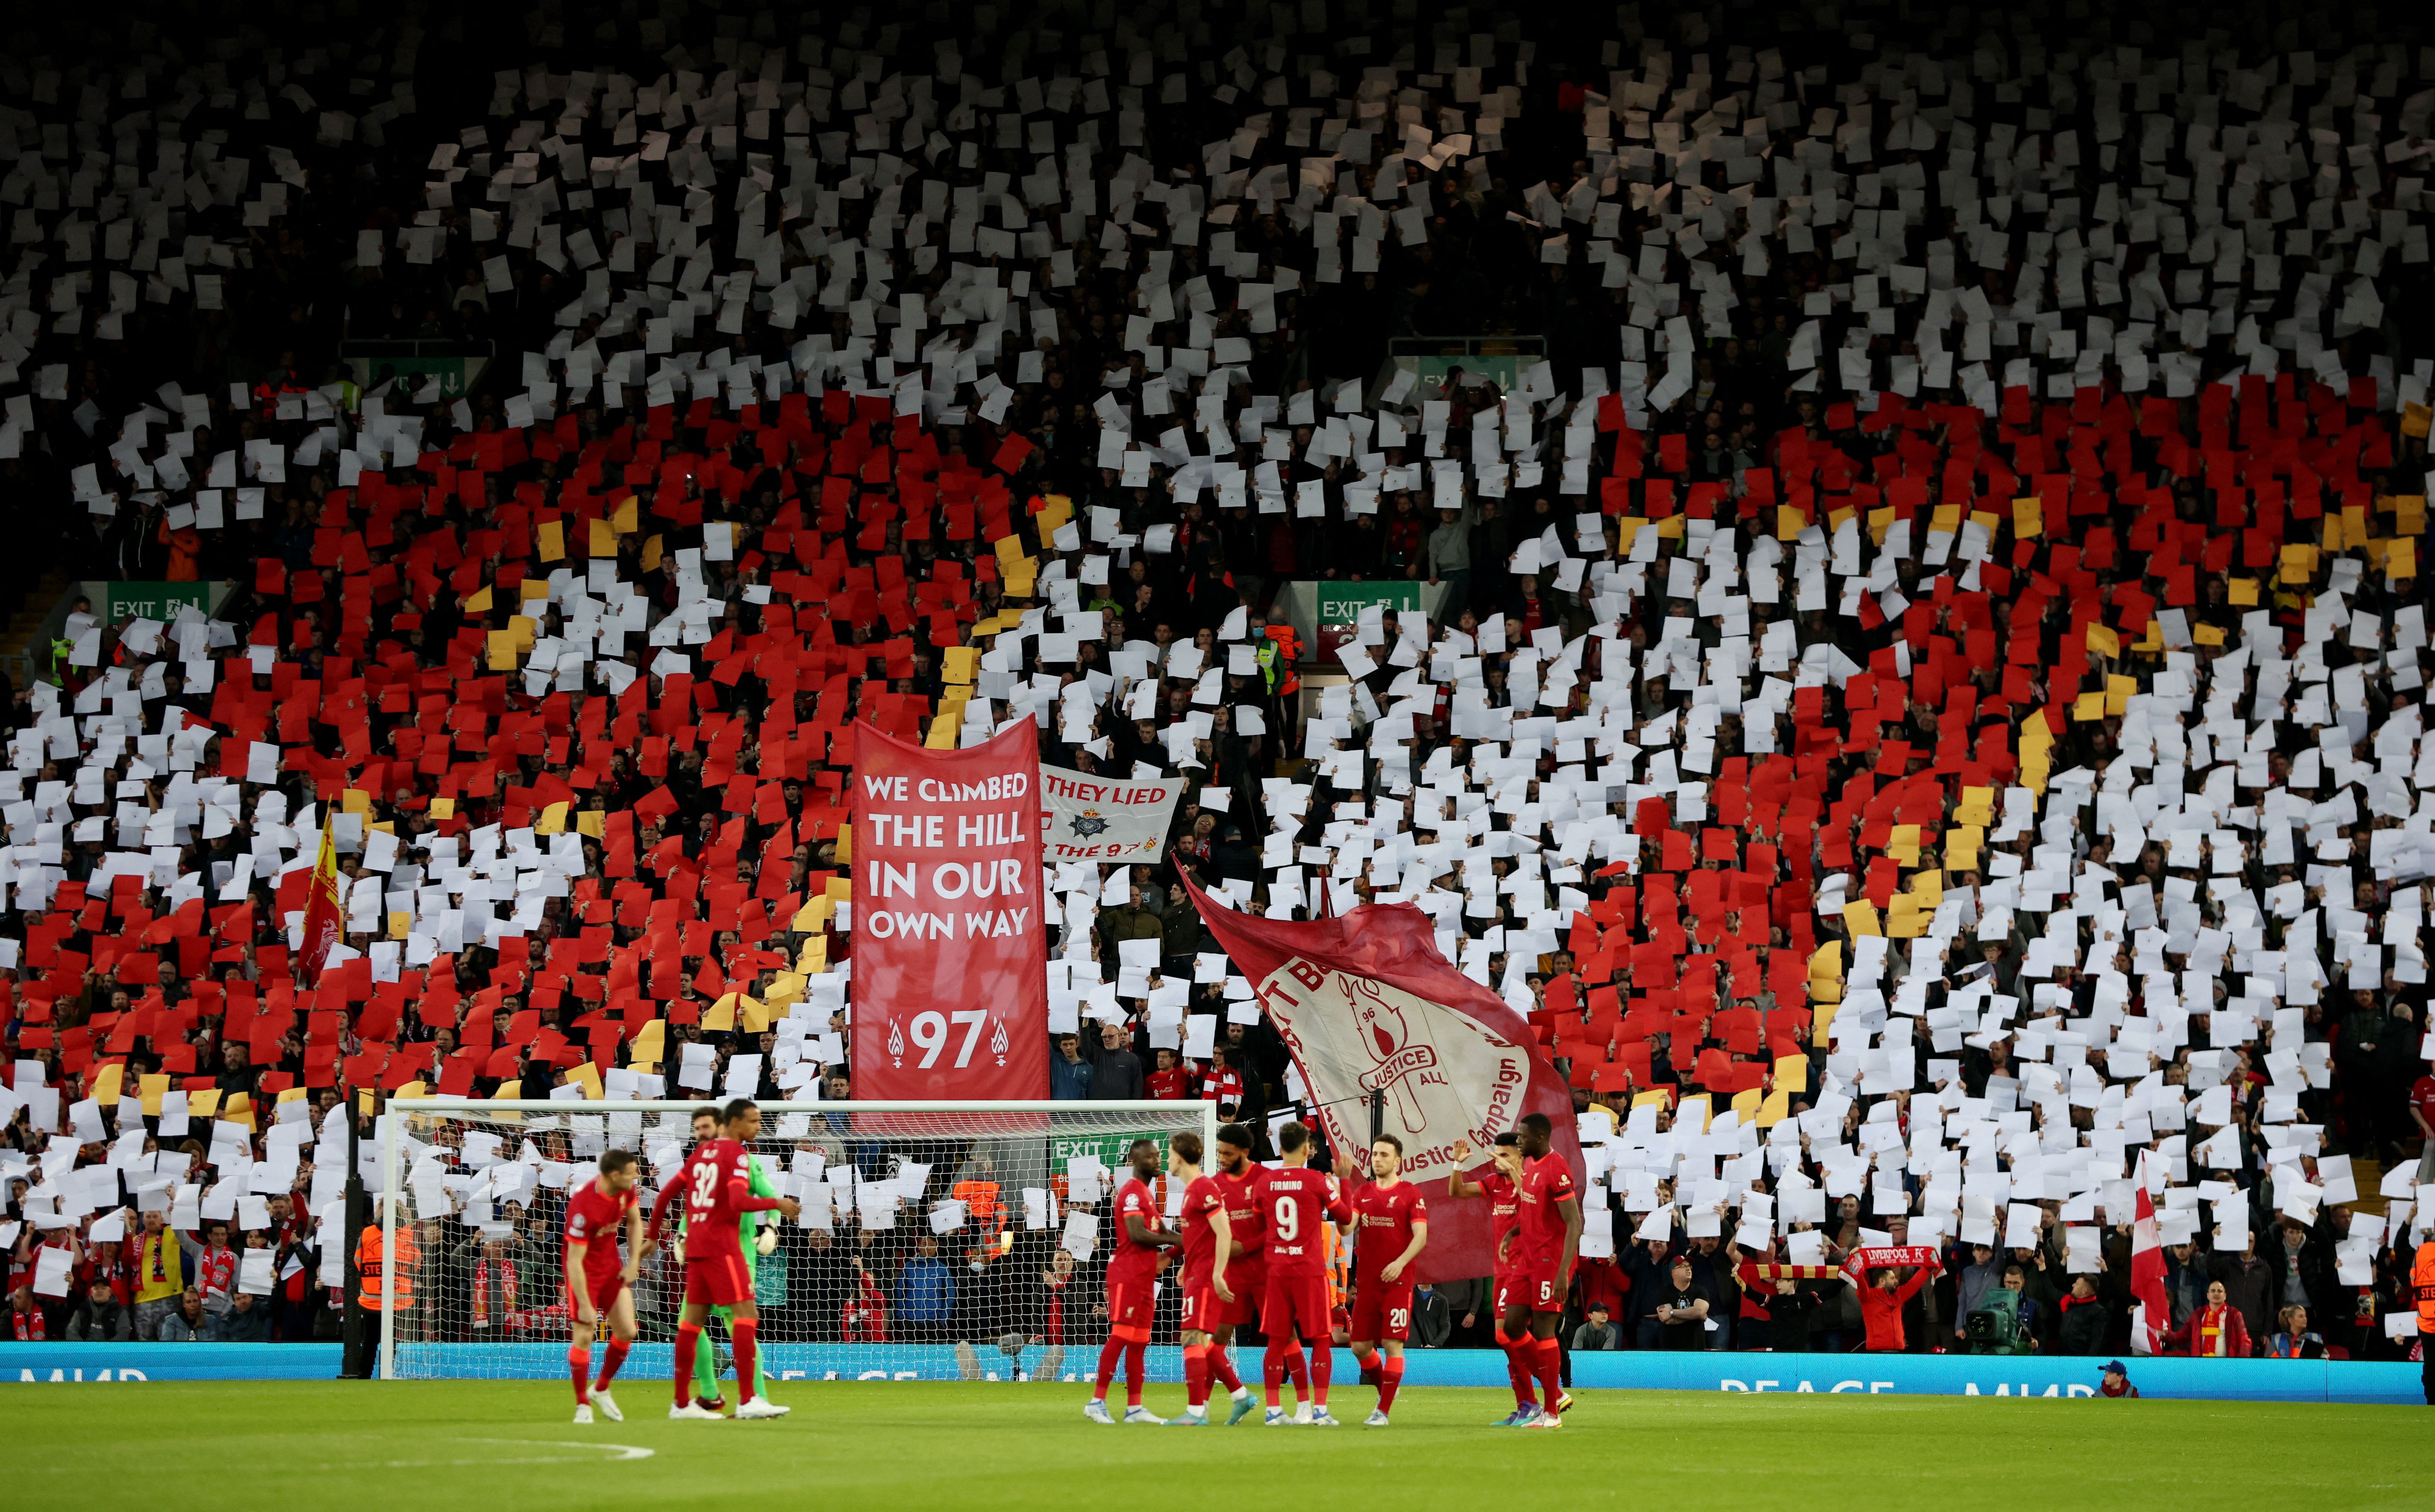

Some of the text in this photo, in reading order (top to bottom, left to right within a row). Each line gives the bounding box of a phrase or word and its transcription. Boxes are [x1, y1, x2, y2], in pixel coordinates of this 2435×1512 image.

[113, 601, 156, 617] EXIT
[1323, 601, 1366, 617] EXIT
[863, 772, 1027, 802] WE CLIMBED
[1046, 775, 1166, 805] THEY LIED
[868, 813, 944, 847] THE
[958, 811, 1025, 847] HILL
[1055, 843, 1101, 857] THE
[1106, 842, 1141, 857] 97
[869, 859, 1024, 900] IN OUR
[868, 906, 1029, 940] OWN WAY
[1362, 1007, 1376, 1023] 96
[910, 1009, 988, 1069] 97
[1369, 1049, 1429, 1089] JUSTICE
[1419, 1071, 1448, 1086] ALL
[1396, 1140, 1470, 1176] Justic
[1468, 1058, 1523, 1148] Campaign
[1056, 1141, 1103, 1158] EXIT
[691, 1162, 719, 1208] 32
[1270, 1180, 1303, 1191] FIRMINO
[1275, 1196, 1299, 1241] 9
[1866, 1248, 1925, 1260] LIVERPOOL FC
[1541, 1281, 1551, 1300] 5
[1390, 1308, 1408, 1327] 20
